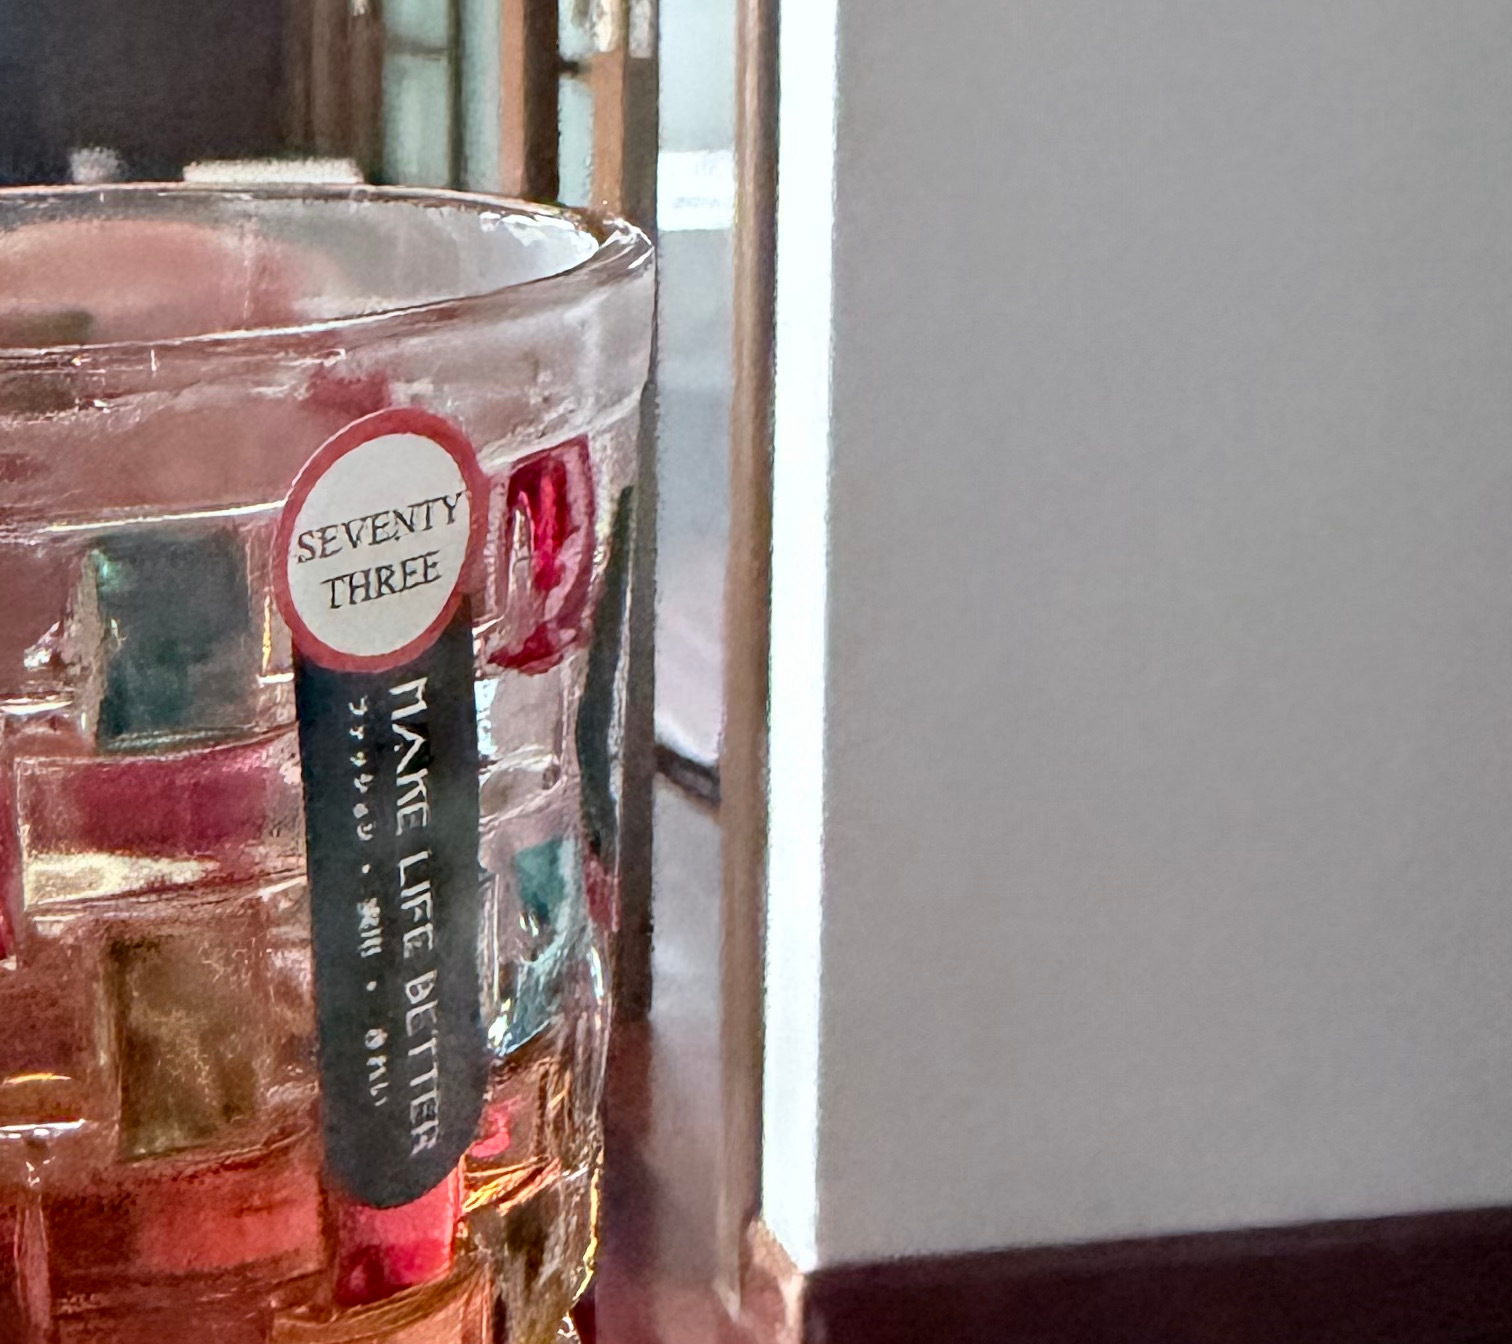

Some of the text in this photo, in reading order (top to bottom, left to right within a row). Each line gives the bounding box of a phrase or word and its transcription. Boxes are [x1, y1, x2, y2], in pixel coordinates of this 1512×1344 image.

[294, 489, 469, 565] SEVENTY
[320, 549, 443, 609] THREE
[389, 676, 441, 1157] MAKE LIFE BETTER
